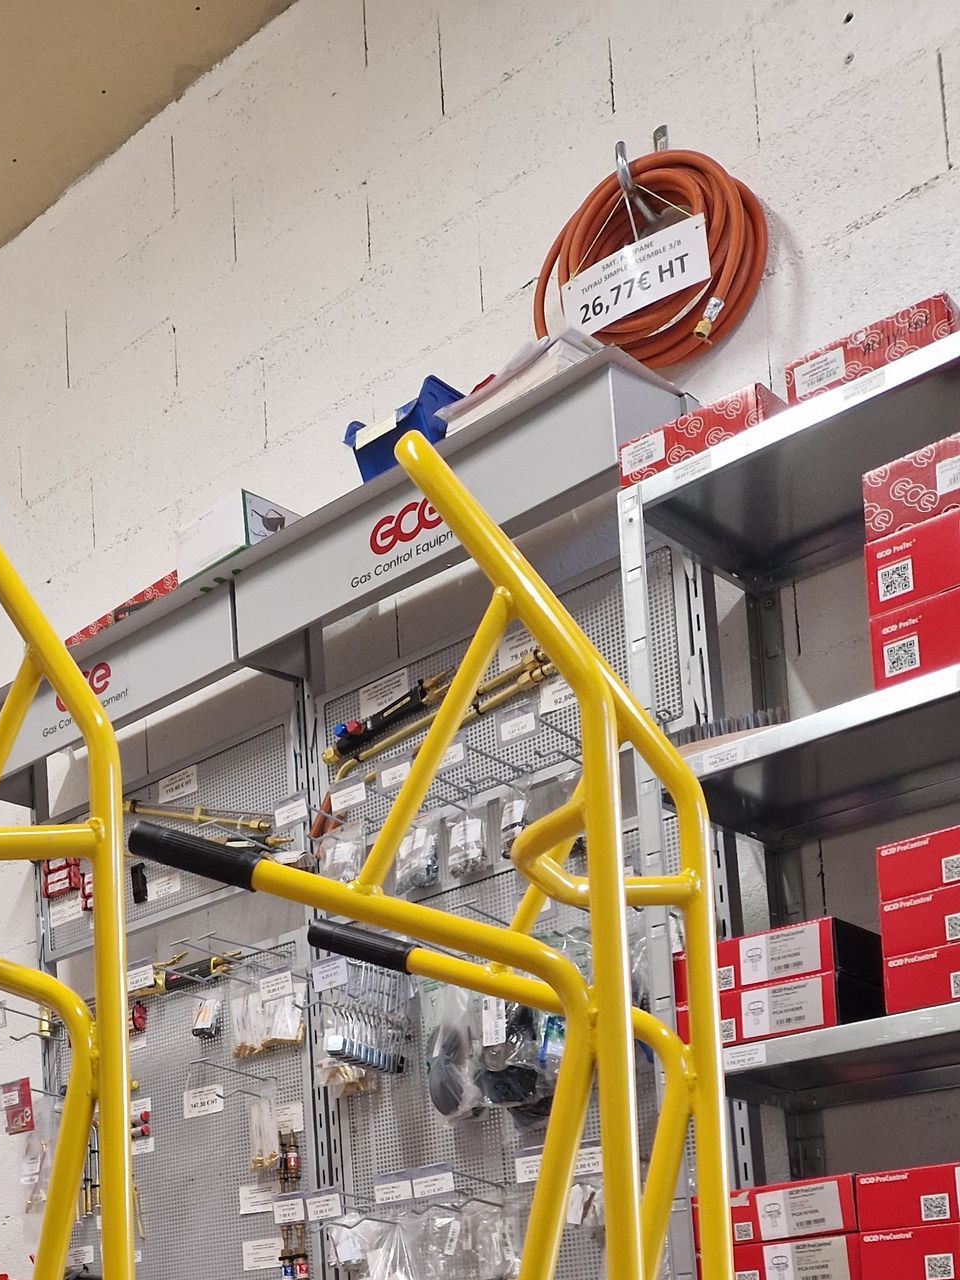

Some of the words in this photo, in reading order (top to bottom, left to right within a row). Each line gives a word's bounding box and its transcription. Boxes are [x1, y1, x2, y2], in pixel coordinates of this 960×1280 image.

[579, 270, 652, 325] 26,77€
[657, 252, 689, 283] HT
[580, 276, 603, 295] TUYAU
[603, 264, 628, 281] SIMPLE
[350, 572, 372, 589] Gas
[374, 548, 413, 577] Control
[42, 723, 58, 738] Gas
[875, 1173, 908, 1183] ProControl
[879, 1231, 912, 1241] ProControl
